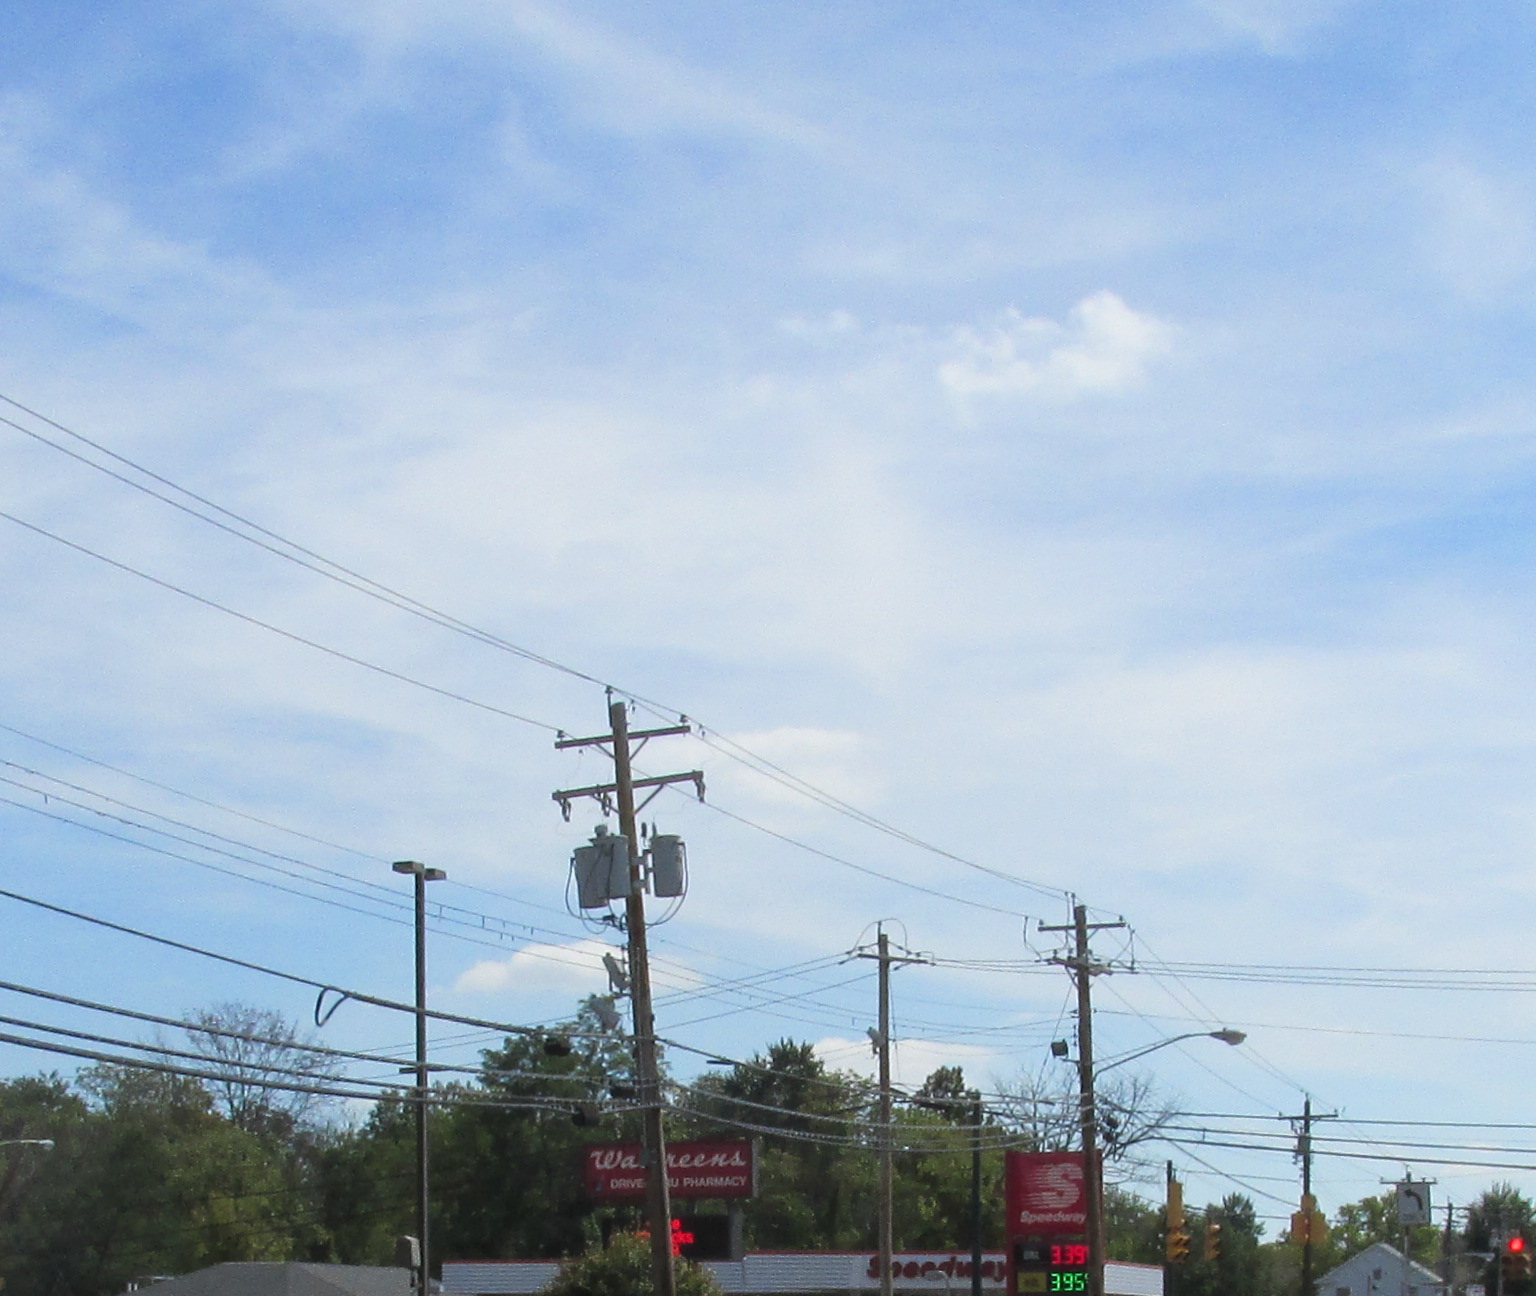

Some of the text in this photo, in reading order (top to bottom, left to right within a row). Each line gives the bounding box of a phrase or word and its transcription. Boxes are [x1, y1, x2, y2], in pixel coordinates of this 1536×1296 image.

[590, 1149, 747, 1170] Wareens
[683, 1176, 747, 1188] PHARMACY
[1020, 1211, 1086, 1225] Speedway
